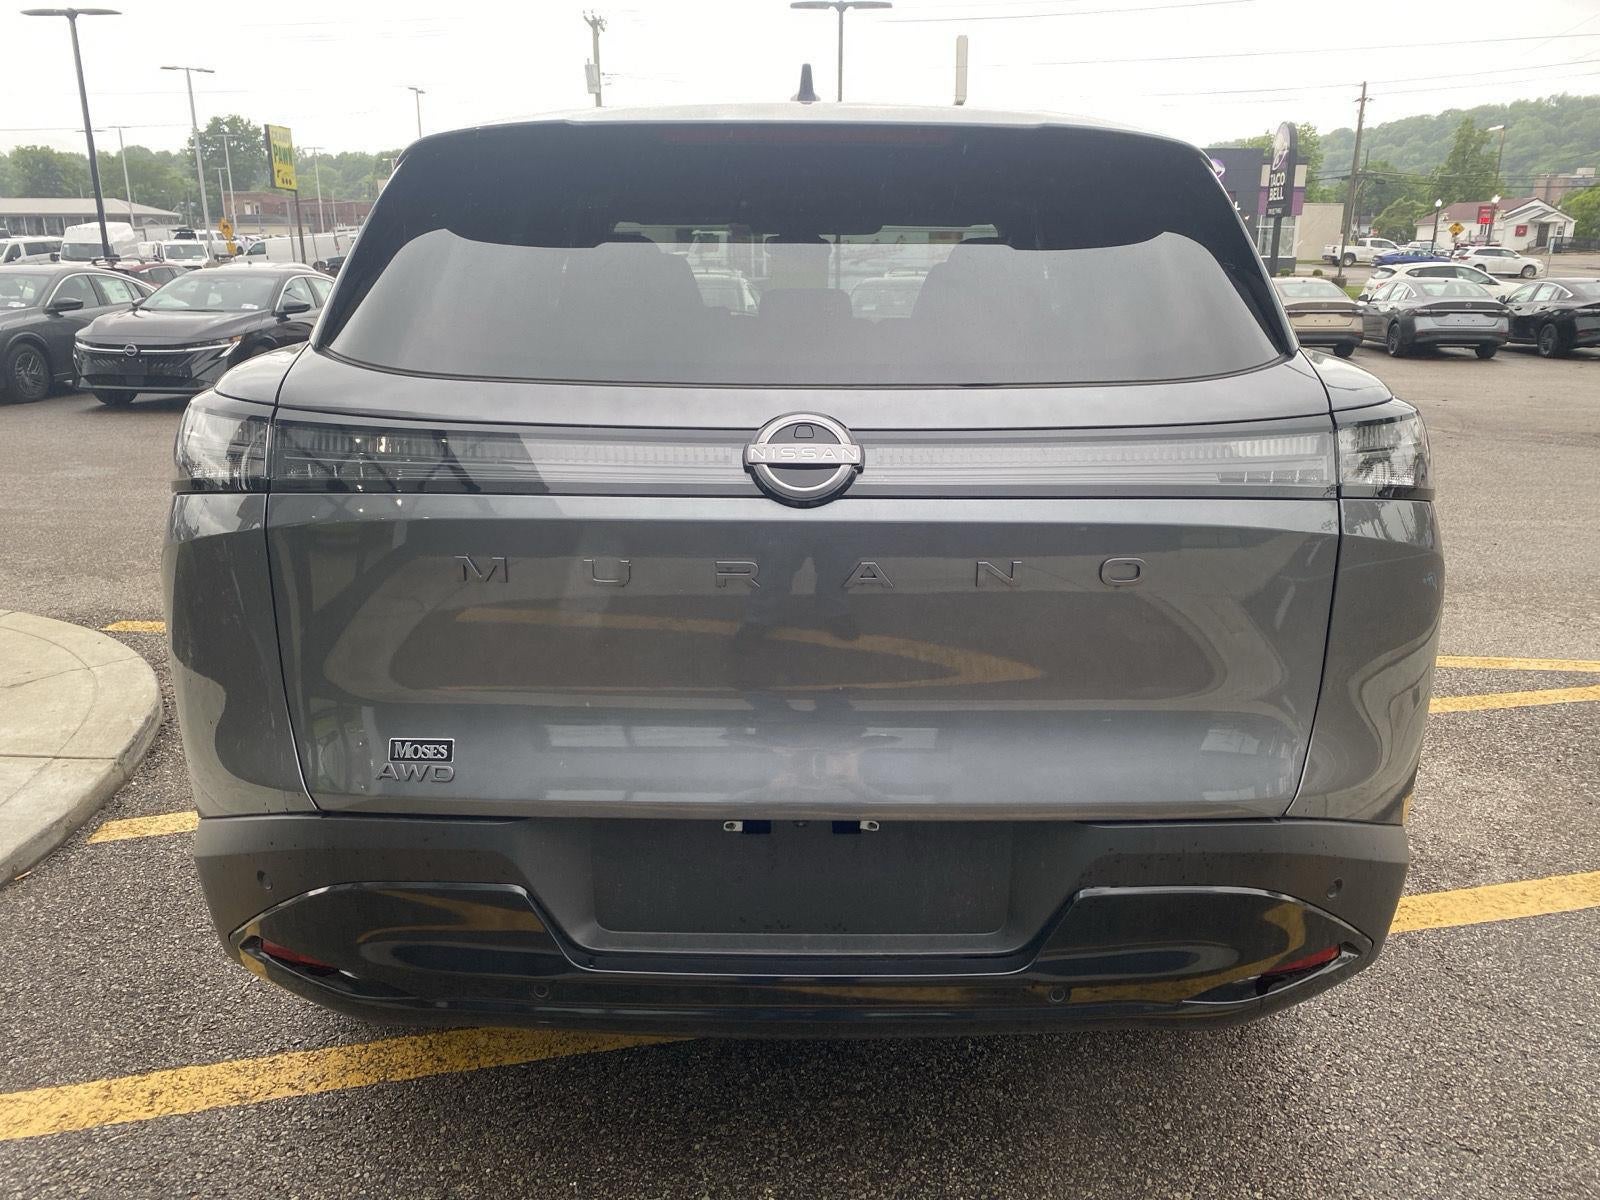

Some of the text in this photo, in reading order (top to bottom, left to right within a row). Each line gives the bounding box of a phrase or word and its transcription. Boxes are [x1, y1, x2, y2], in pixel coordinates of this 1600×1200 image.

[1270, 172, 1286, 187] TACO
[1268, 187, 1284, 202] BELL
[750, 447, 858, 460] NISSAN
[454, 555, 1149, 588] MURANO
[393, 741, 448, 759] MOSES
[376, 762, 456, 783] AWD
